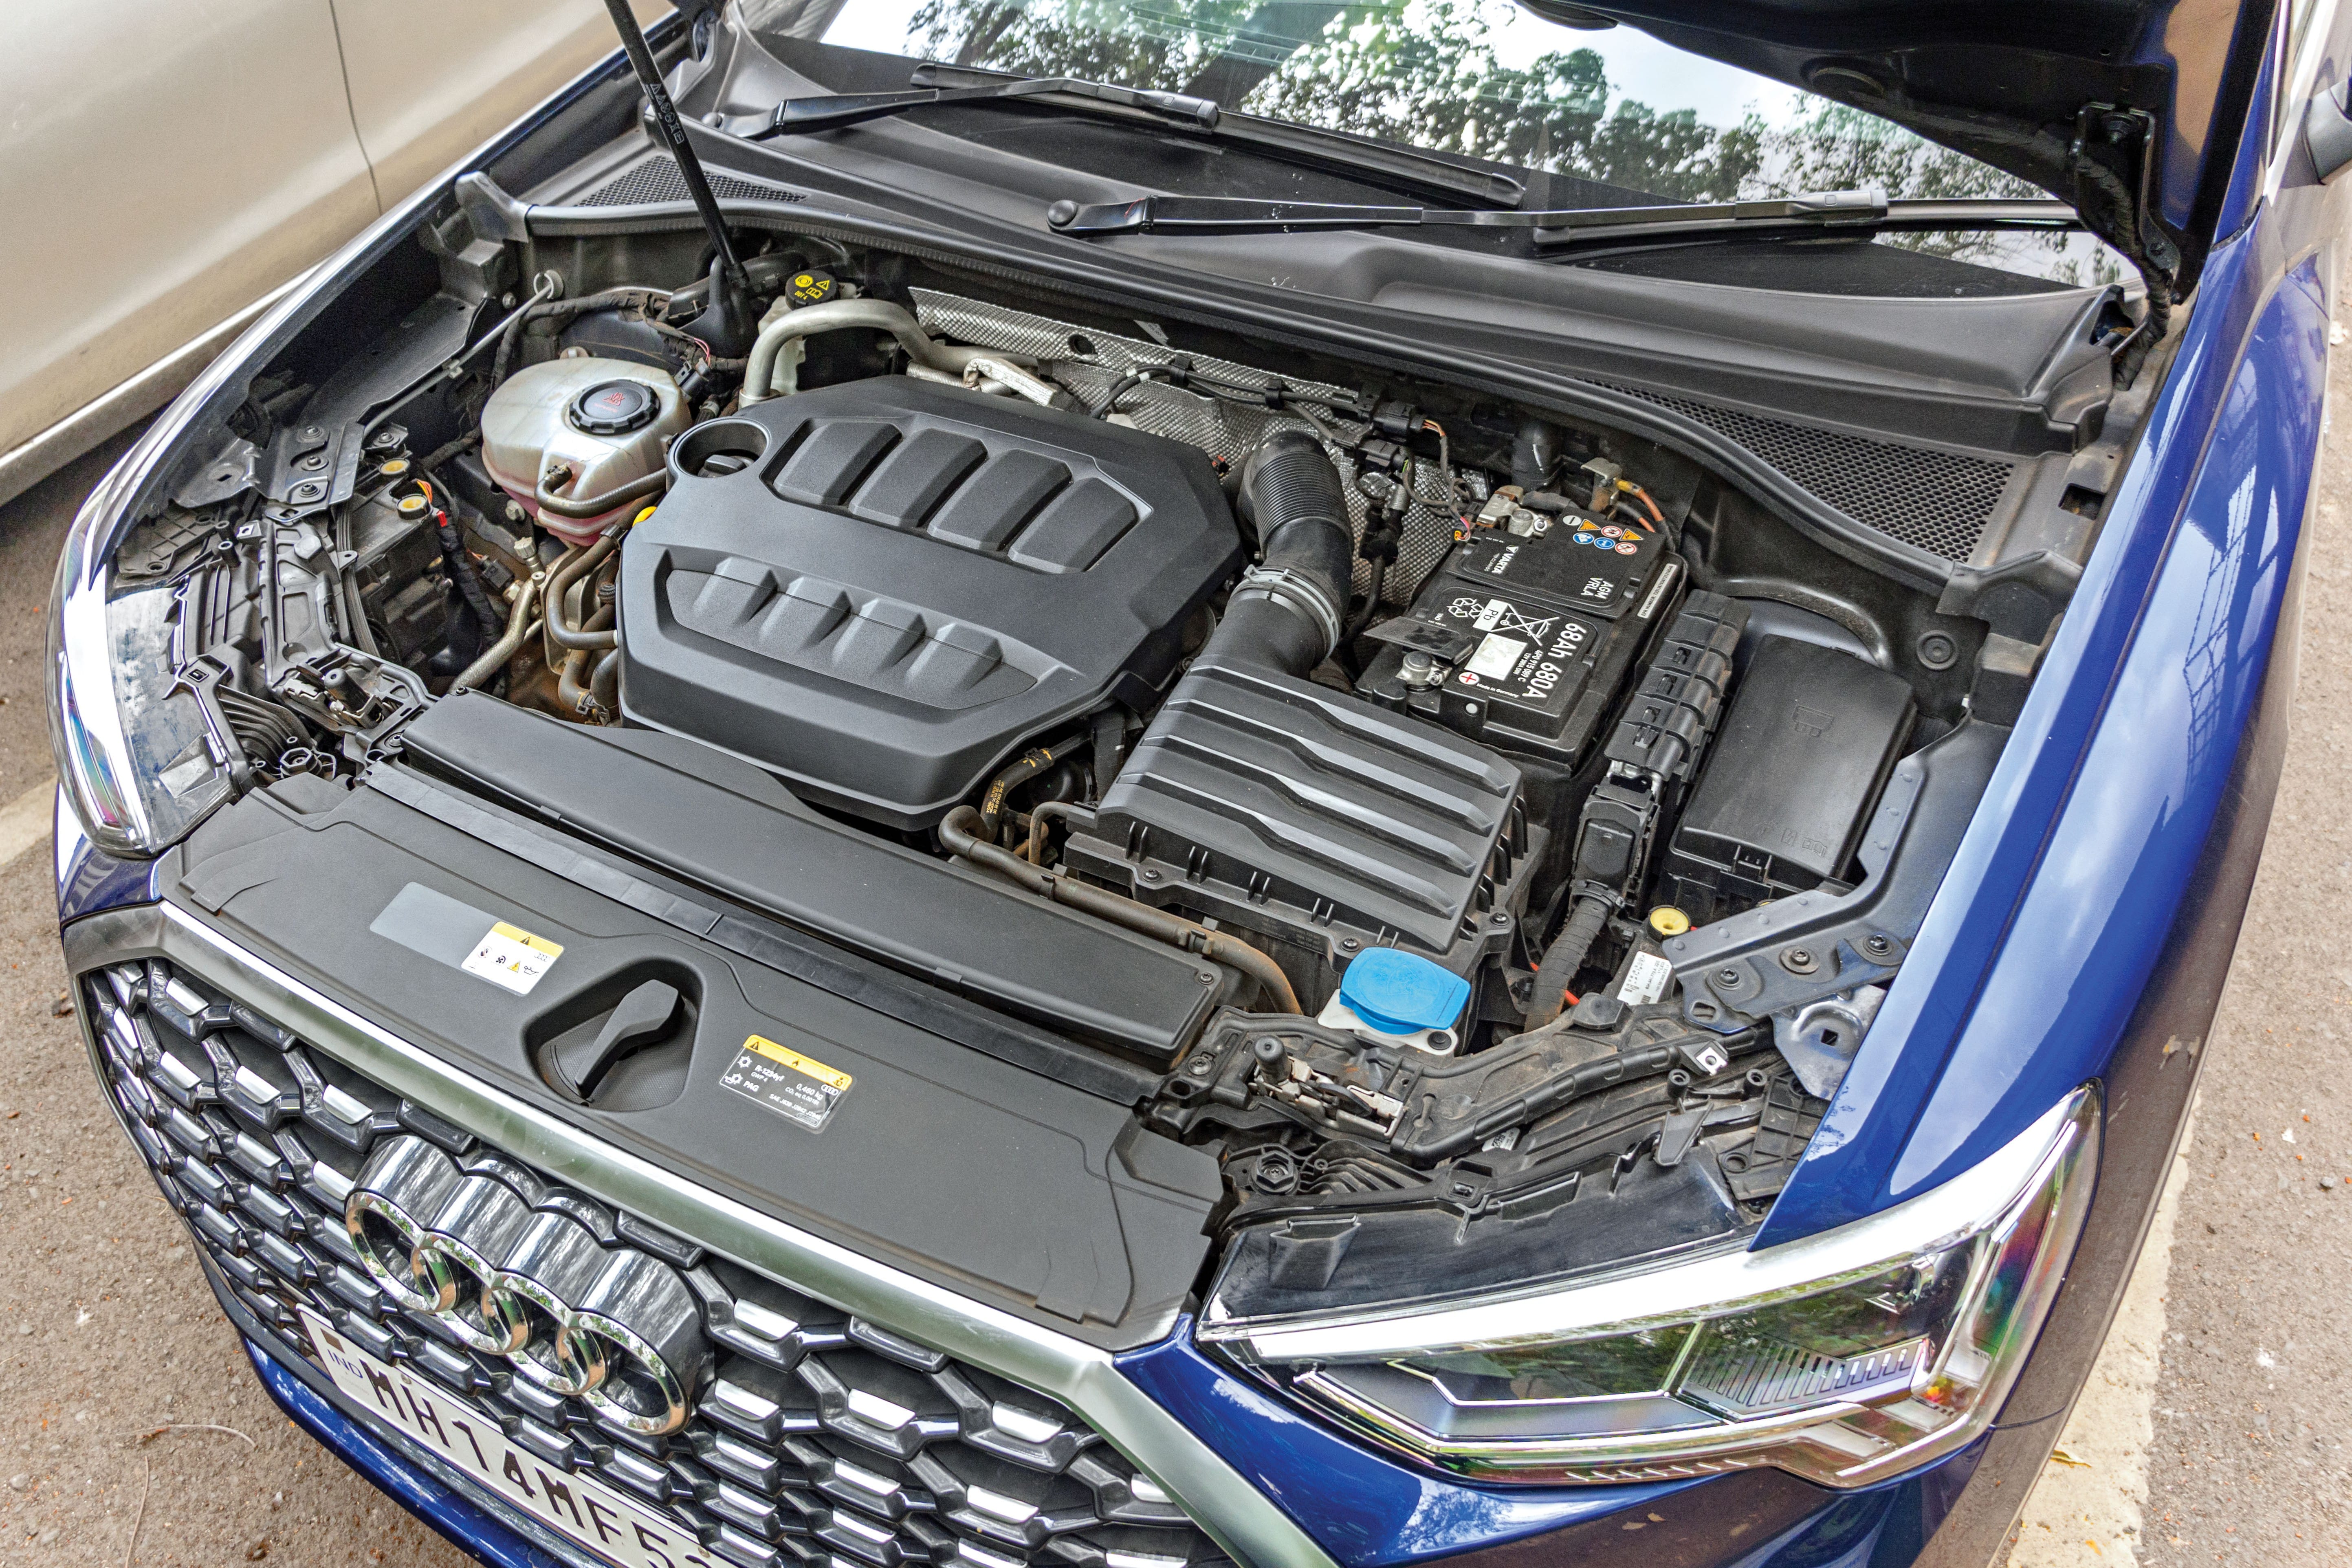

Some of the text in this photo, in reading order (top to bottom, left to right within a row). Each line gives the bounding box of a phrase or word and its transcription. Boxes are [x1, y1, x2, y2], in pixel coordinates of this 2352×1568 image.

[1484, 558, 1496, 571] CLARIOS
[1492, 553, 1514, 573] VARTA
[1581, 578, 1603, 595] VRLA
[1595, 581, 1613, 599] AGM
[1483, 609, 1498, 620] Pb
[1522, 623, 1587, 698] 68Ah 680A
[1526, 660, 1538, 669] 915
[1521, 669, 1532, 678] 089
[1496, 688, 1519, 698] Germany
[751, 1071, 764, 1080] GWP
[755, 1064, 785, 1081] R-1234yf
[814, 1091, 824, 1101] kg
[743, 1080, 759, 1092] PAG
[769, 1093, 781, 1102] SAE
[327, 1349, 363, 1379] IND
